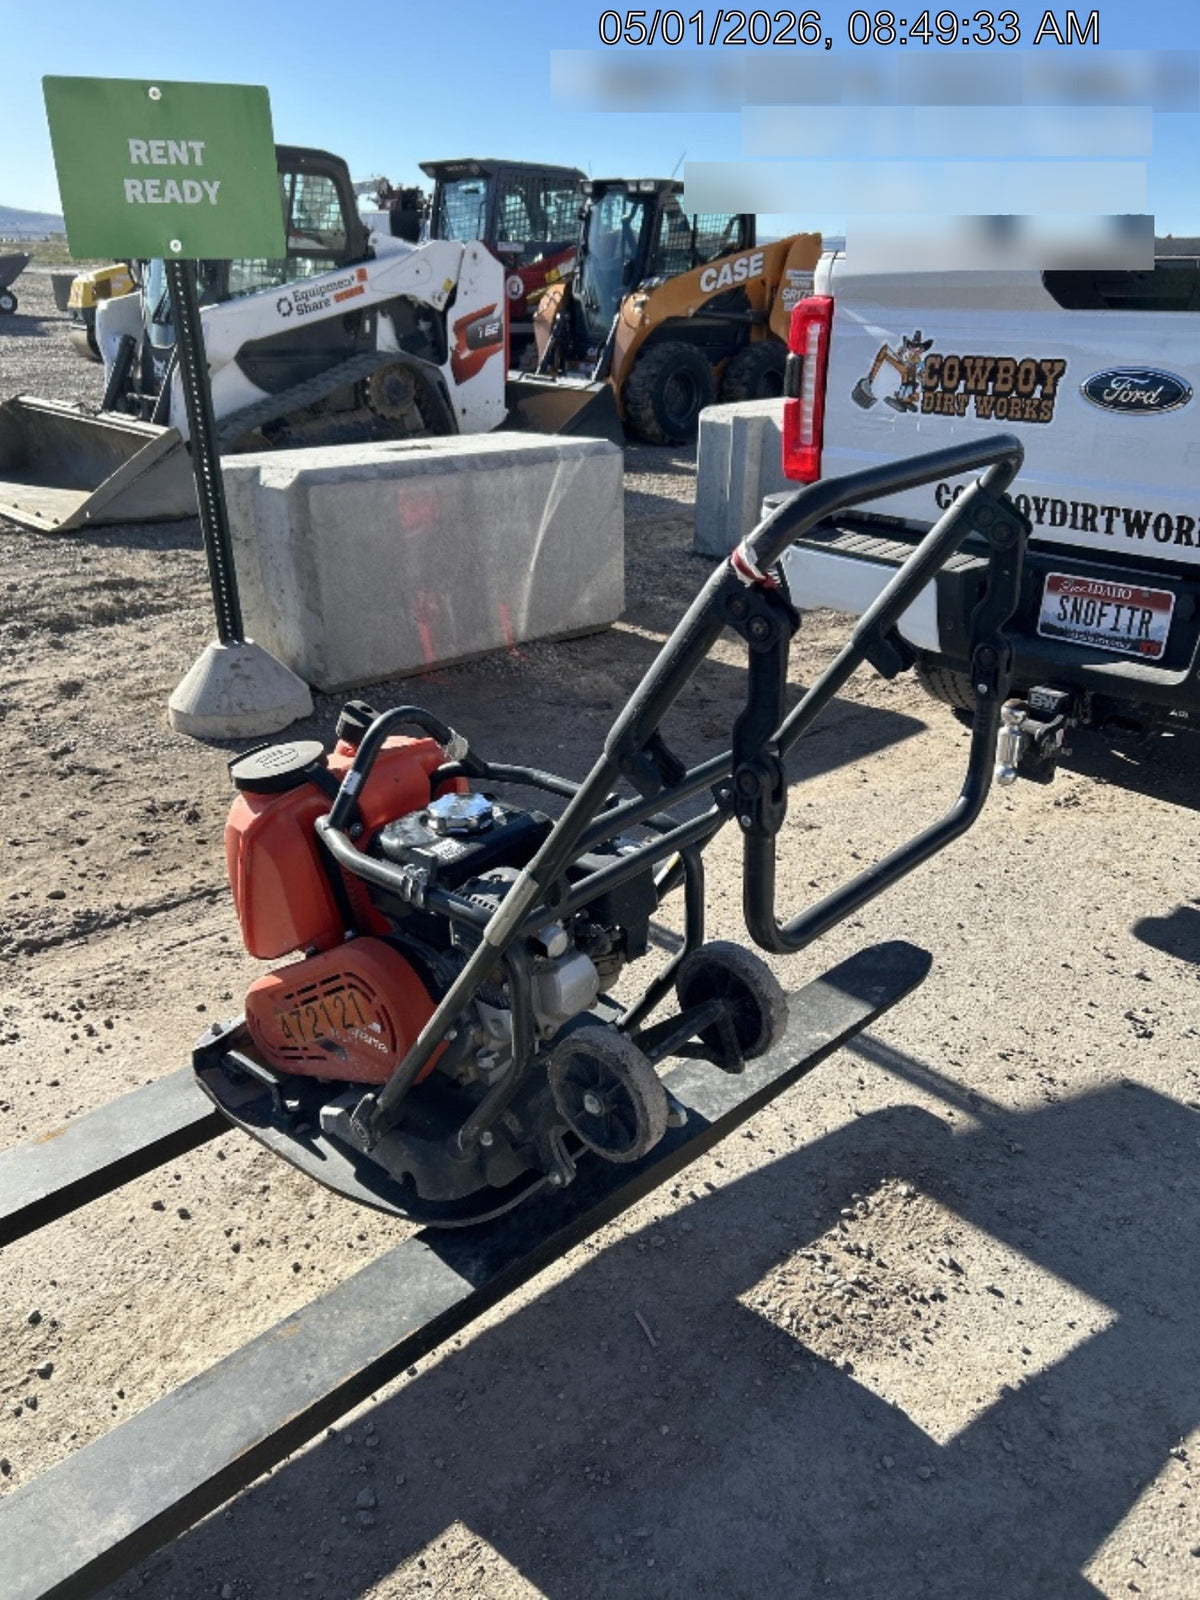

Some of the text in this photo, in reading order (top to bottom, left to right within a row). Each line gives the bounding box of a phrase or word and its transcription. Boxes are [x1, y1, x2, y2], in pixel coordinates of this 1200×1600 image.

[128, 138, 206, 166] RENT
[123, 178, 221, 206] READY
[700, 252, 765, 293] CASE
[296, 297, 332, 316] Share
[923, 353, 1067, 399] COWBOY
[1102, 375, 1164, 405] Ford
[921, 391, 1055, 423] DIRT WORKS
[1086, 582, 1133, 600] IDAHO
[1057, 594, 1153, 638] SNOFITR
[280, 991, 366, 1044] 472121
